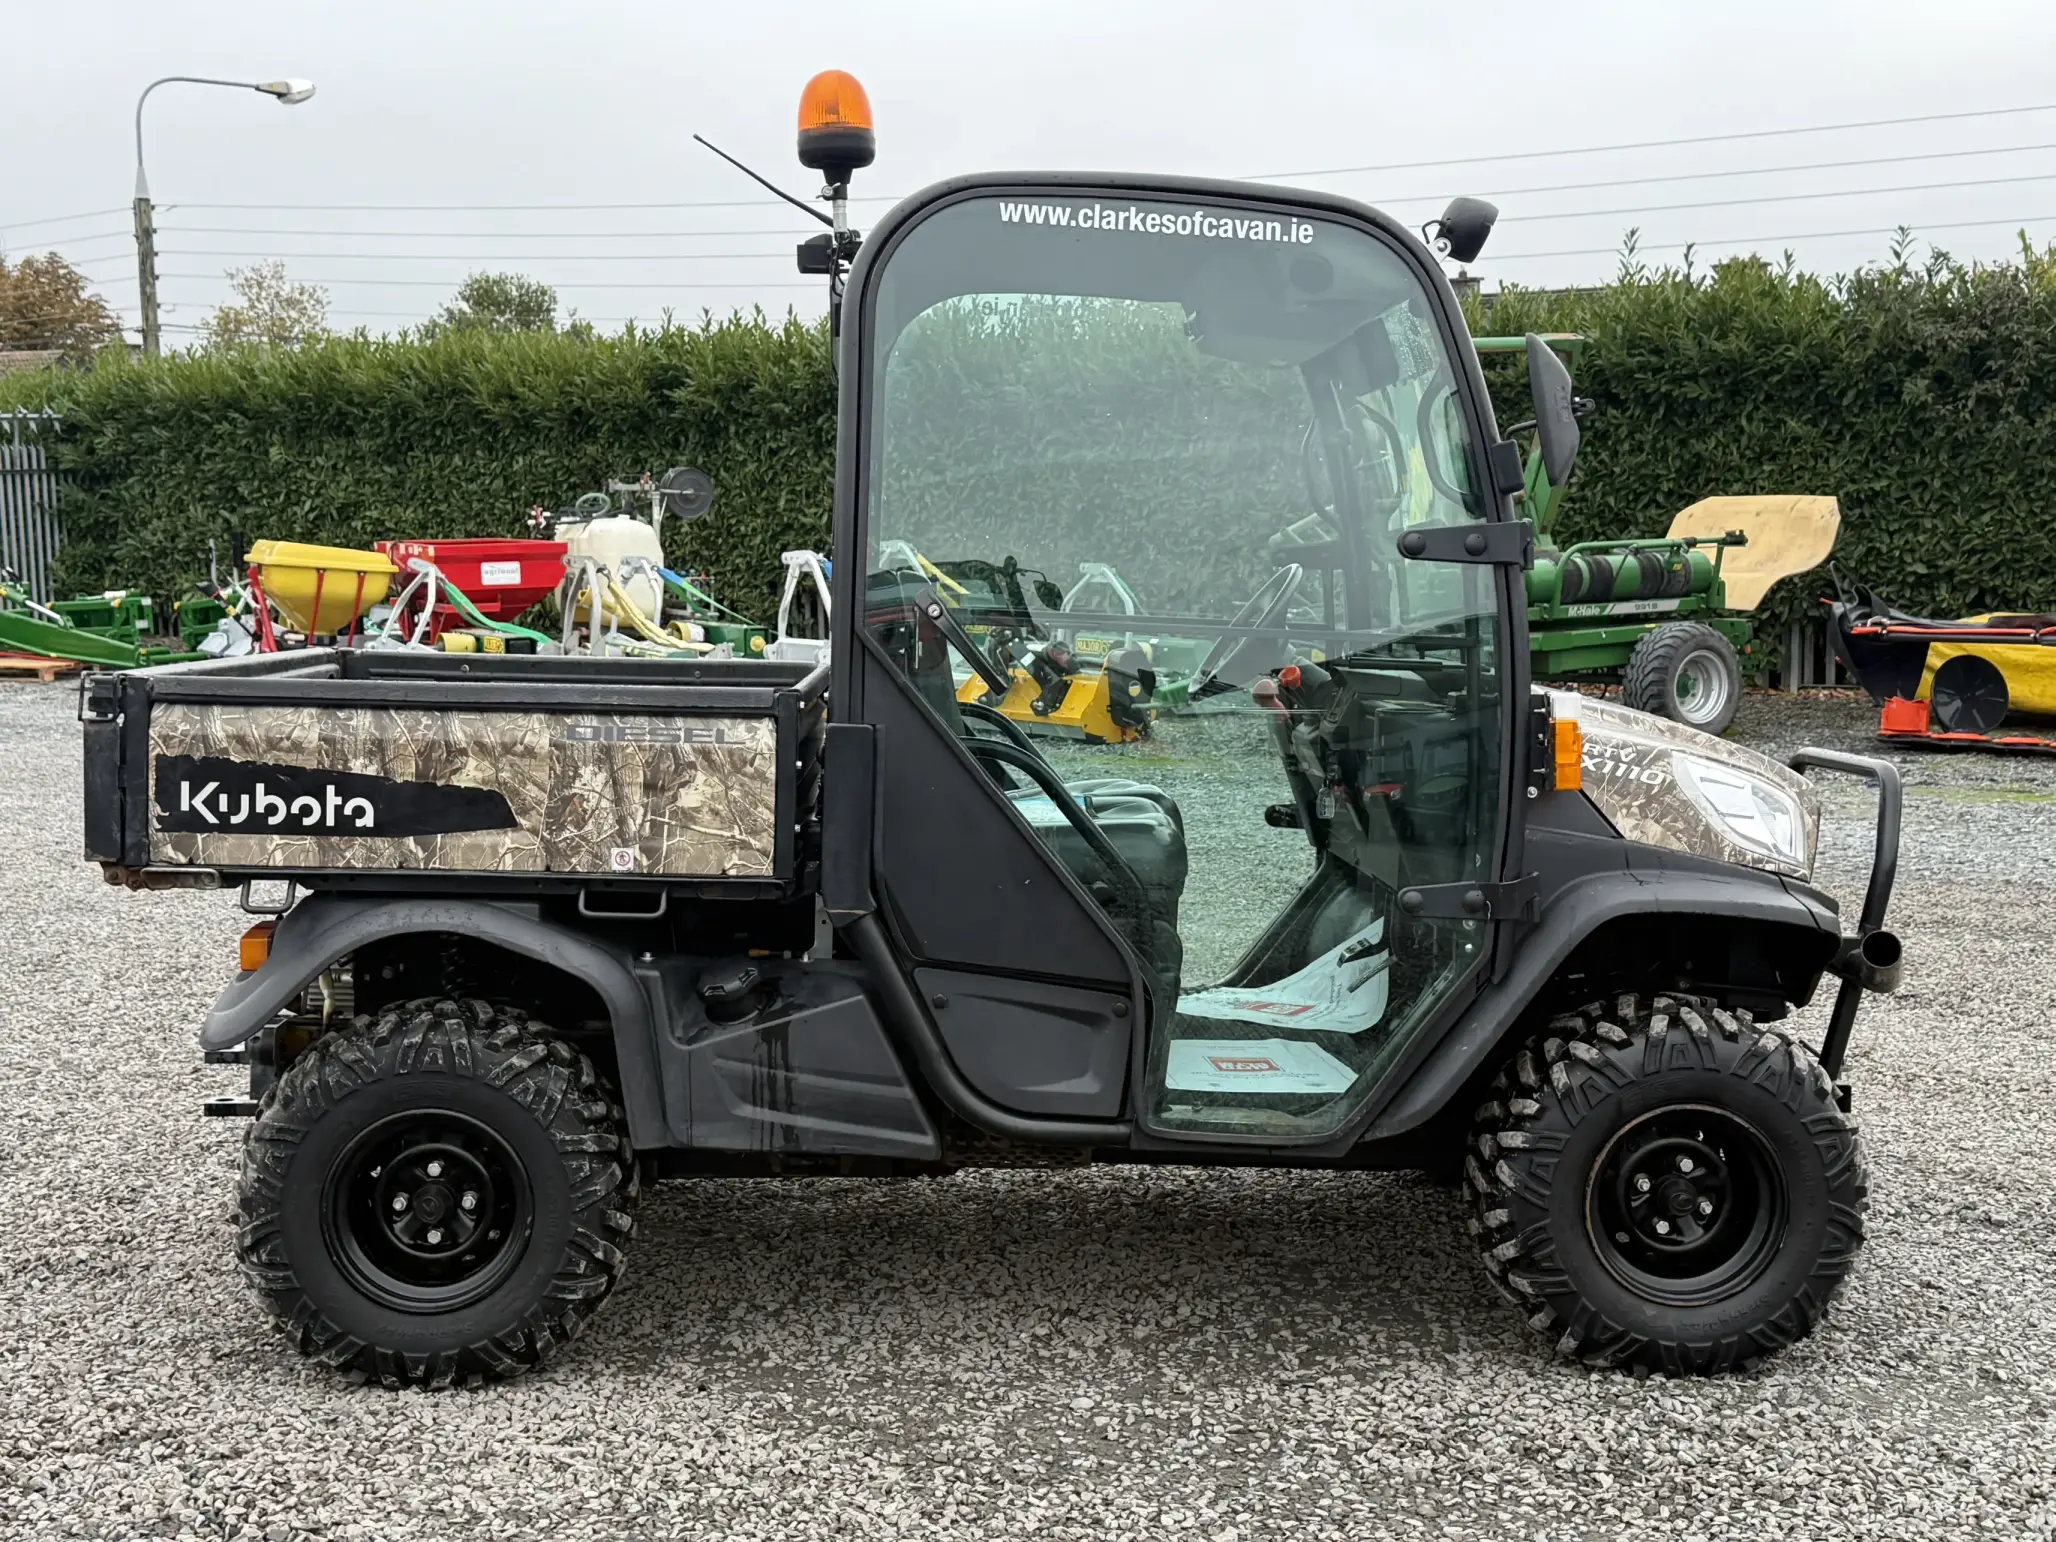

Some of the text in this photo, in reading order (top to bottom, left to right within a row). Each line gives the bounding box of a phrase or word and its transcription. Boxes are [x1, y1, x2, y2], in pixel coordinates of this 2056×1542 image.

[999, 202, 1315, 244] www.clarkesofcavan.ie
[566, 725, 747, 745] DIESEL
[1582, 742, 1637, 763] RTV
[1580, 754, 1665, 786] X1110
[180, 780, 375, 829] Kubota
